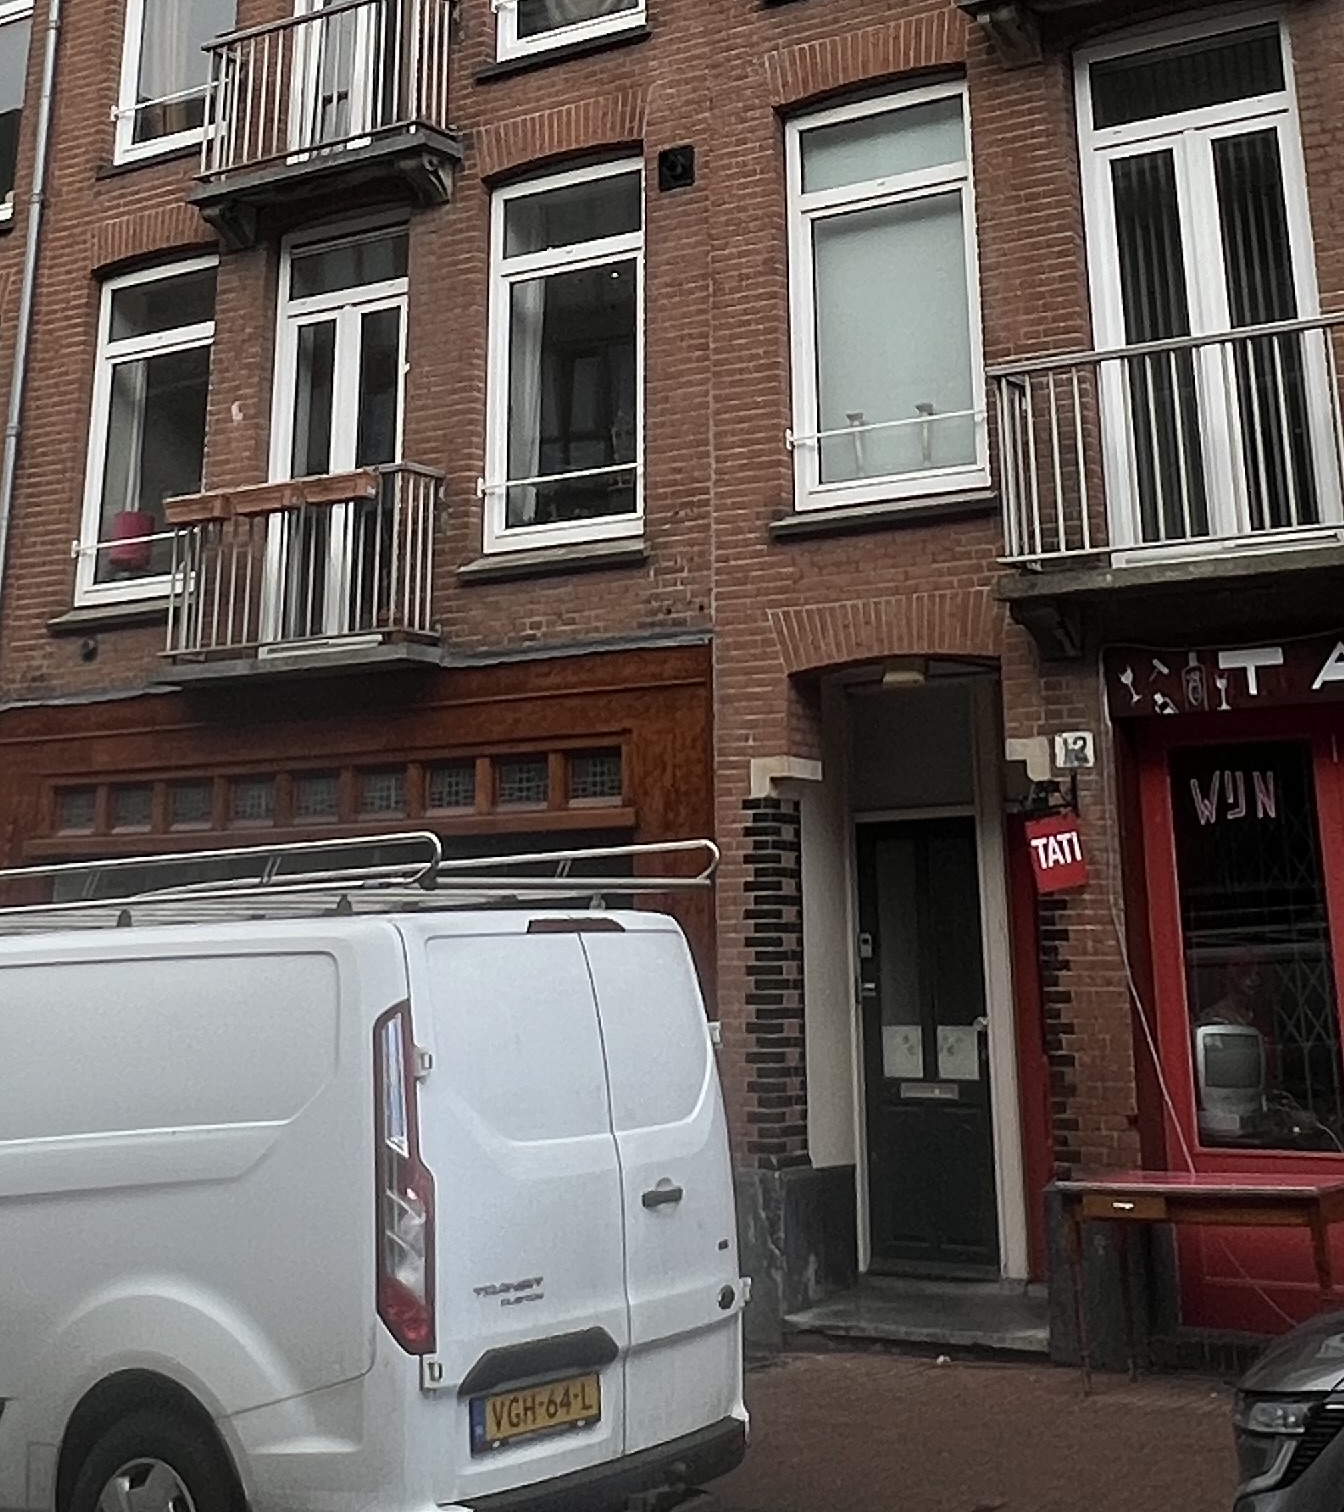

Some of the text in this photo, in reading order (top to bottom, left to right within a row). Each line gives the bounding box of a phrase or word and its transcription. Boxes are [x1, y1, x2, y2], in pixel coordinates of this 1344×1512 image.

[1190, 770, 1276, 826] WIJN
[1030, 830, 1084, 870] TATI
[492, 1382, 593, 1432] VGH-64-L
